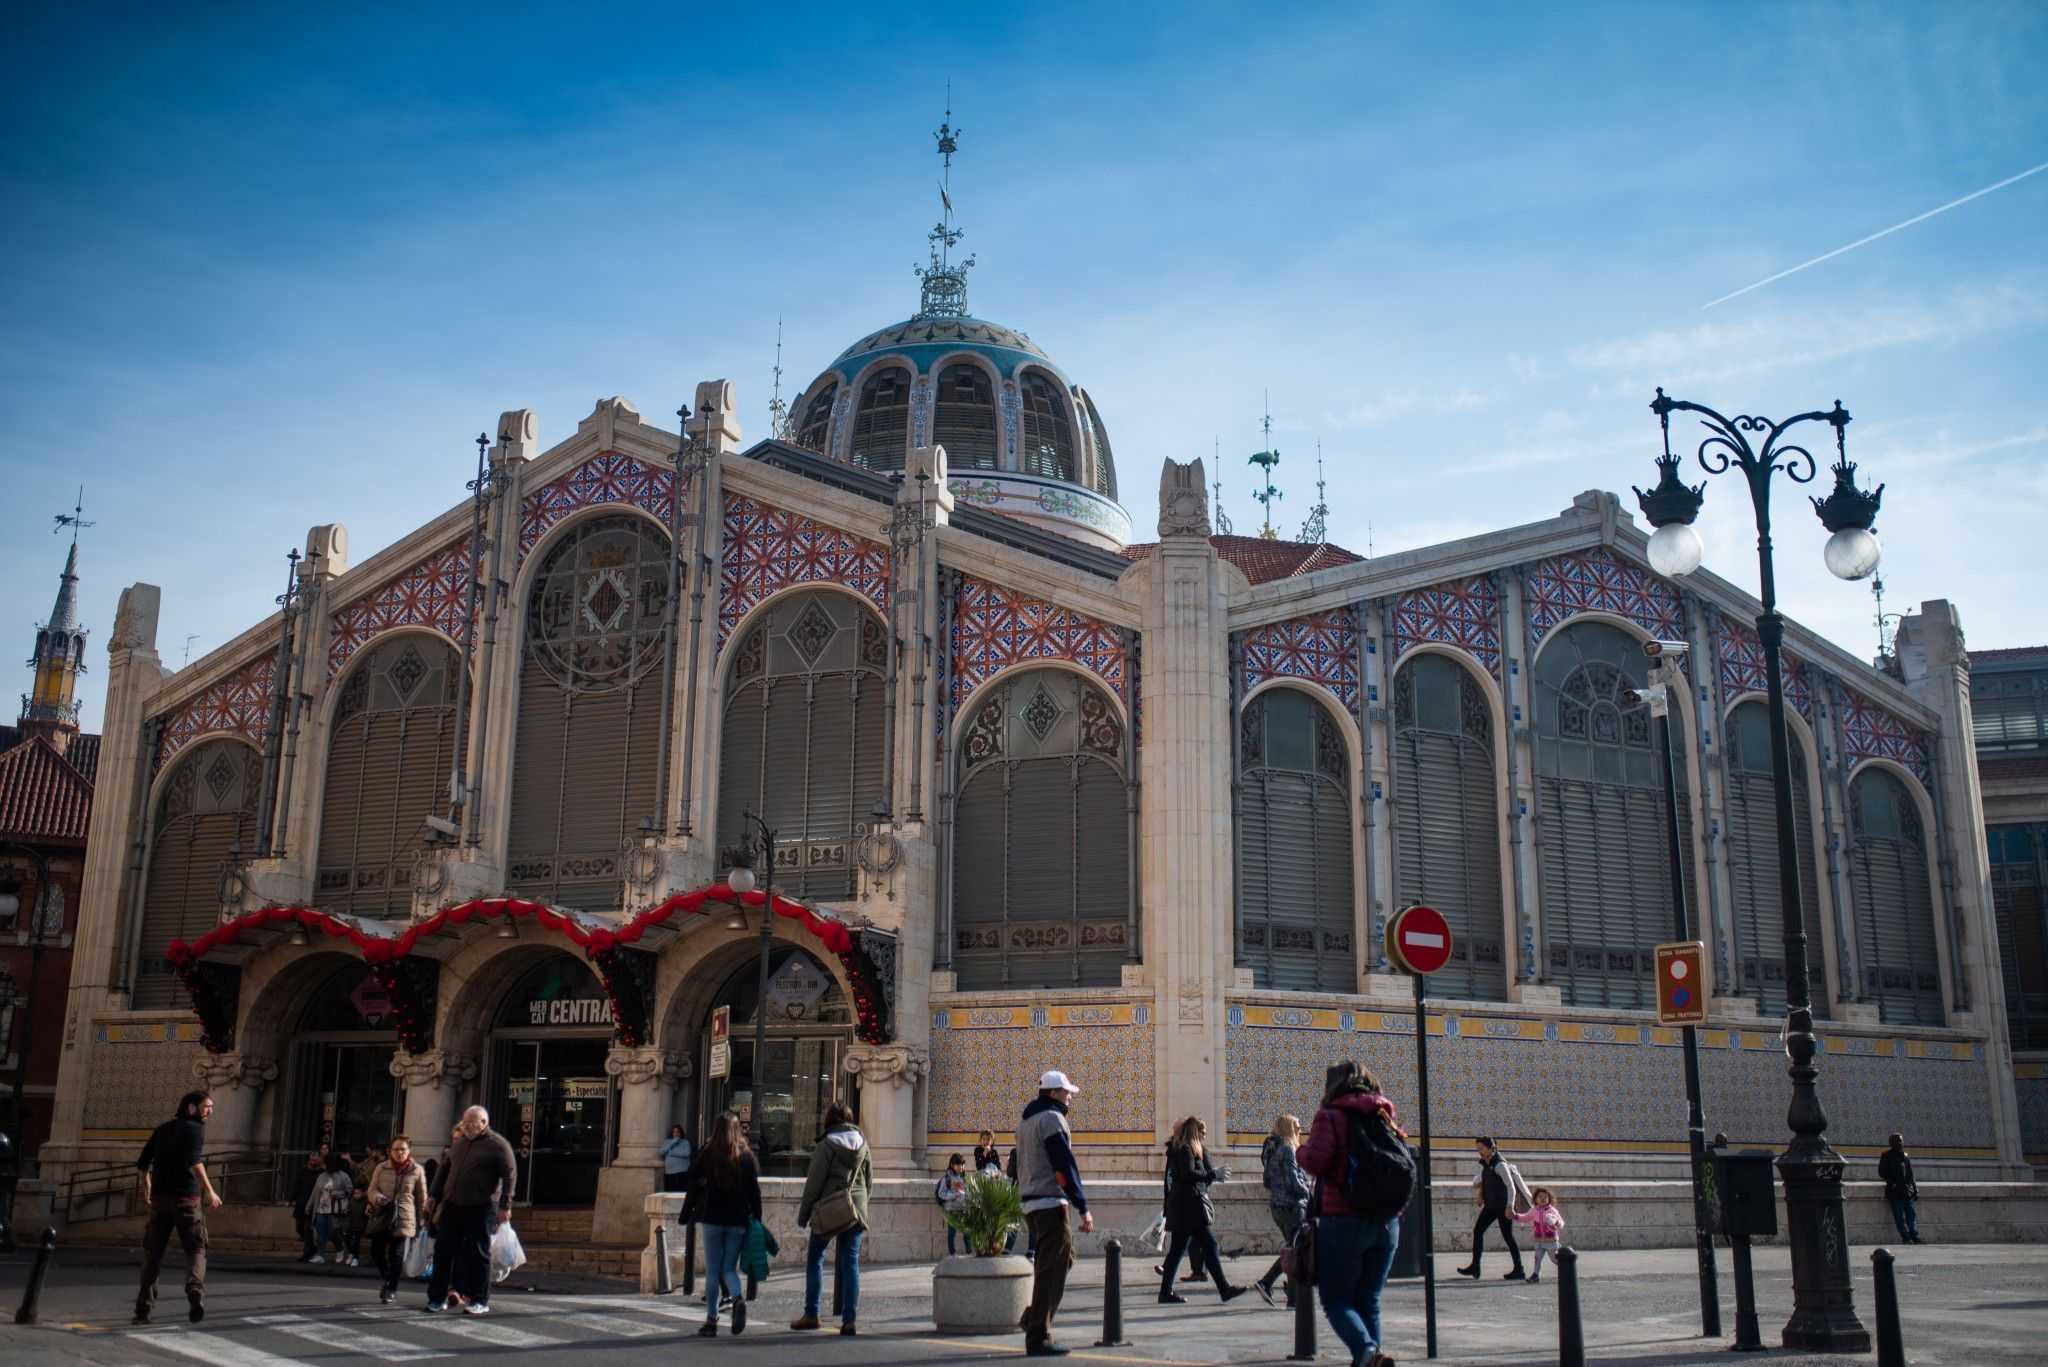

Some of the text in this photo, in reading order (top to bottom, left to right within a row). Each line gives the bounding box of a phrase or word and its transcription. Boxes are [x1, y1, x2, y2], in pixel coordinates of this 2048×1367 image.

[775, 980, 802, 989] PESCADO
[529, 1000, 547, 1013] MER
[531, 1012, 546, 1024] CAT
